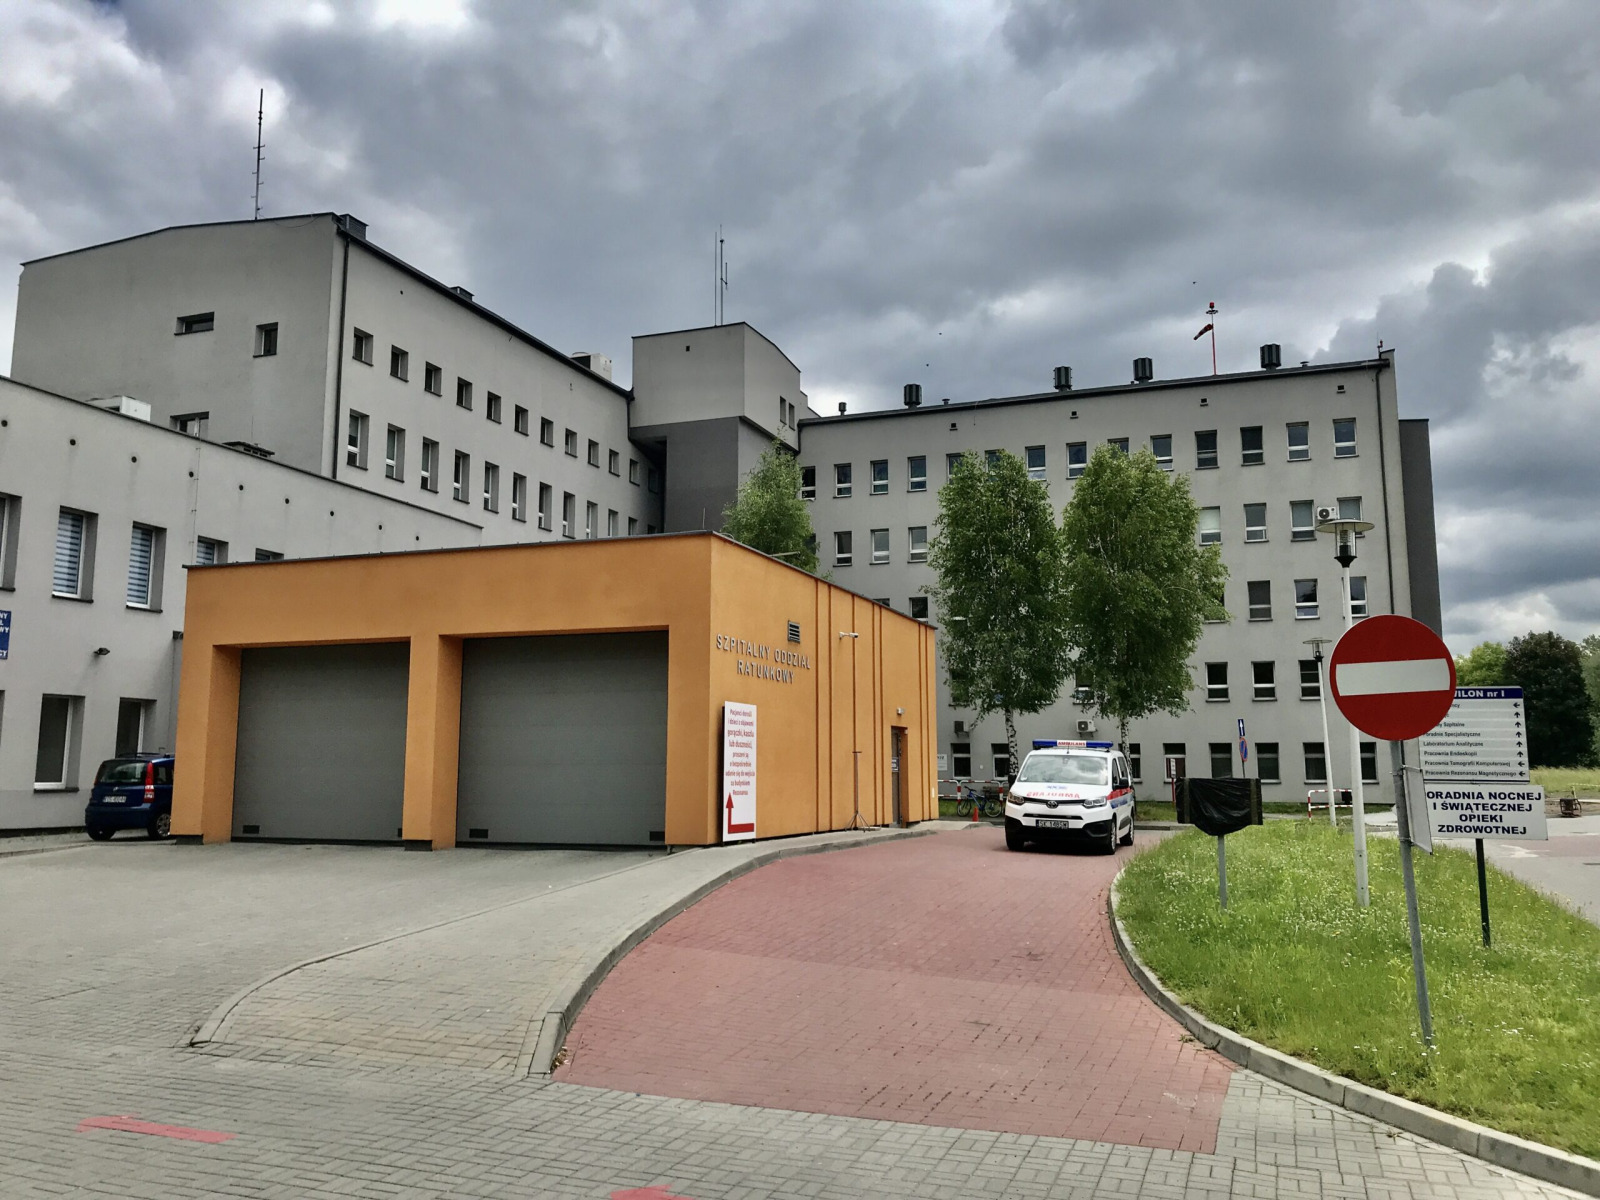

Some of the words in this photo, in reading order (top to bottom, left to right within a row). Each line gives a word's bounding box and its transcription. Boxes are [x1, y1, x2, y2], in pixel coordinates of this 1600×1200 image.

[716, 634, 770, 659] SZPITALNY
[737, 659, 794, 684] RATUNKOWY
[1426, 791, 1484, 800] ORADNIA
[1488, 792, 1542, 801] NOCNEJ
[1433, 802, 1437, 810] I
[1441, 800, 1533, 813] ŚWIĄTECZNEJ
[1459, 814, 1503, 823] OPIEKI
[1438, 824, 1527, 835] ZDROWOTNEJ
